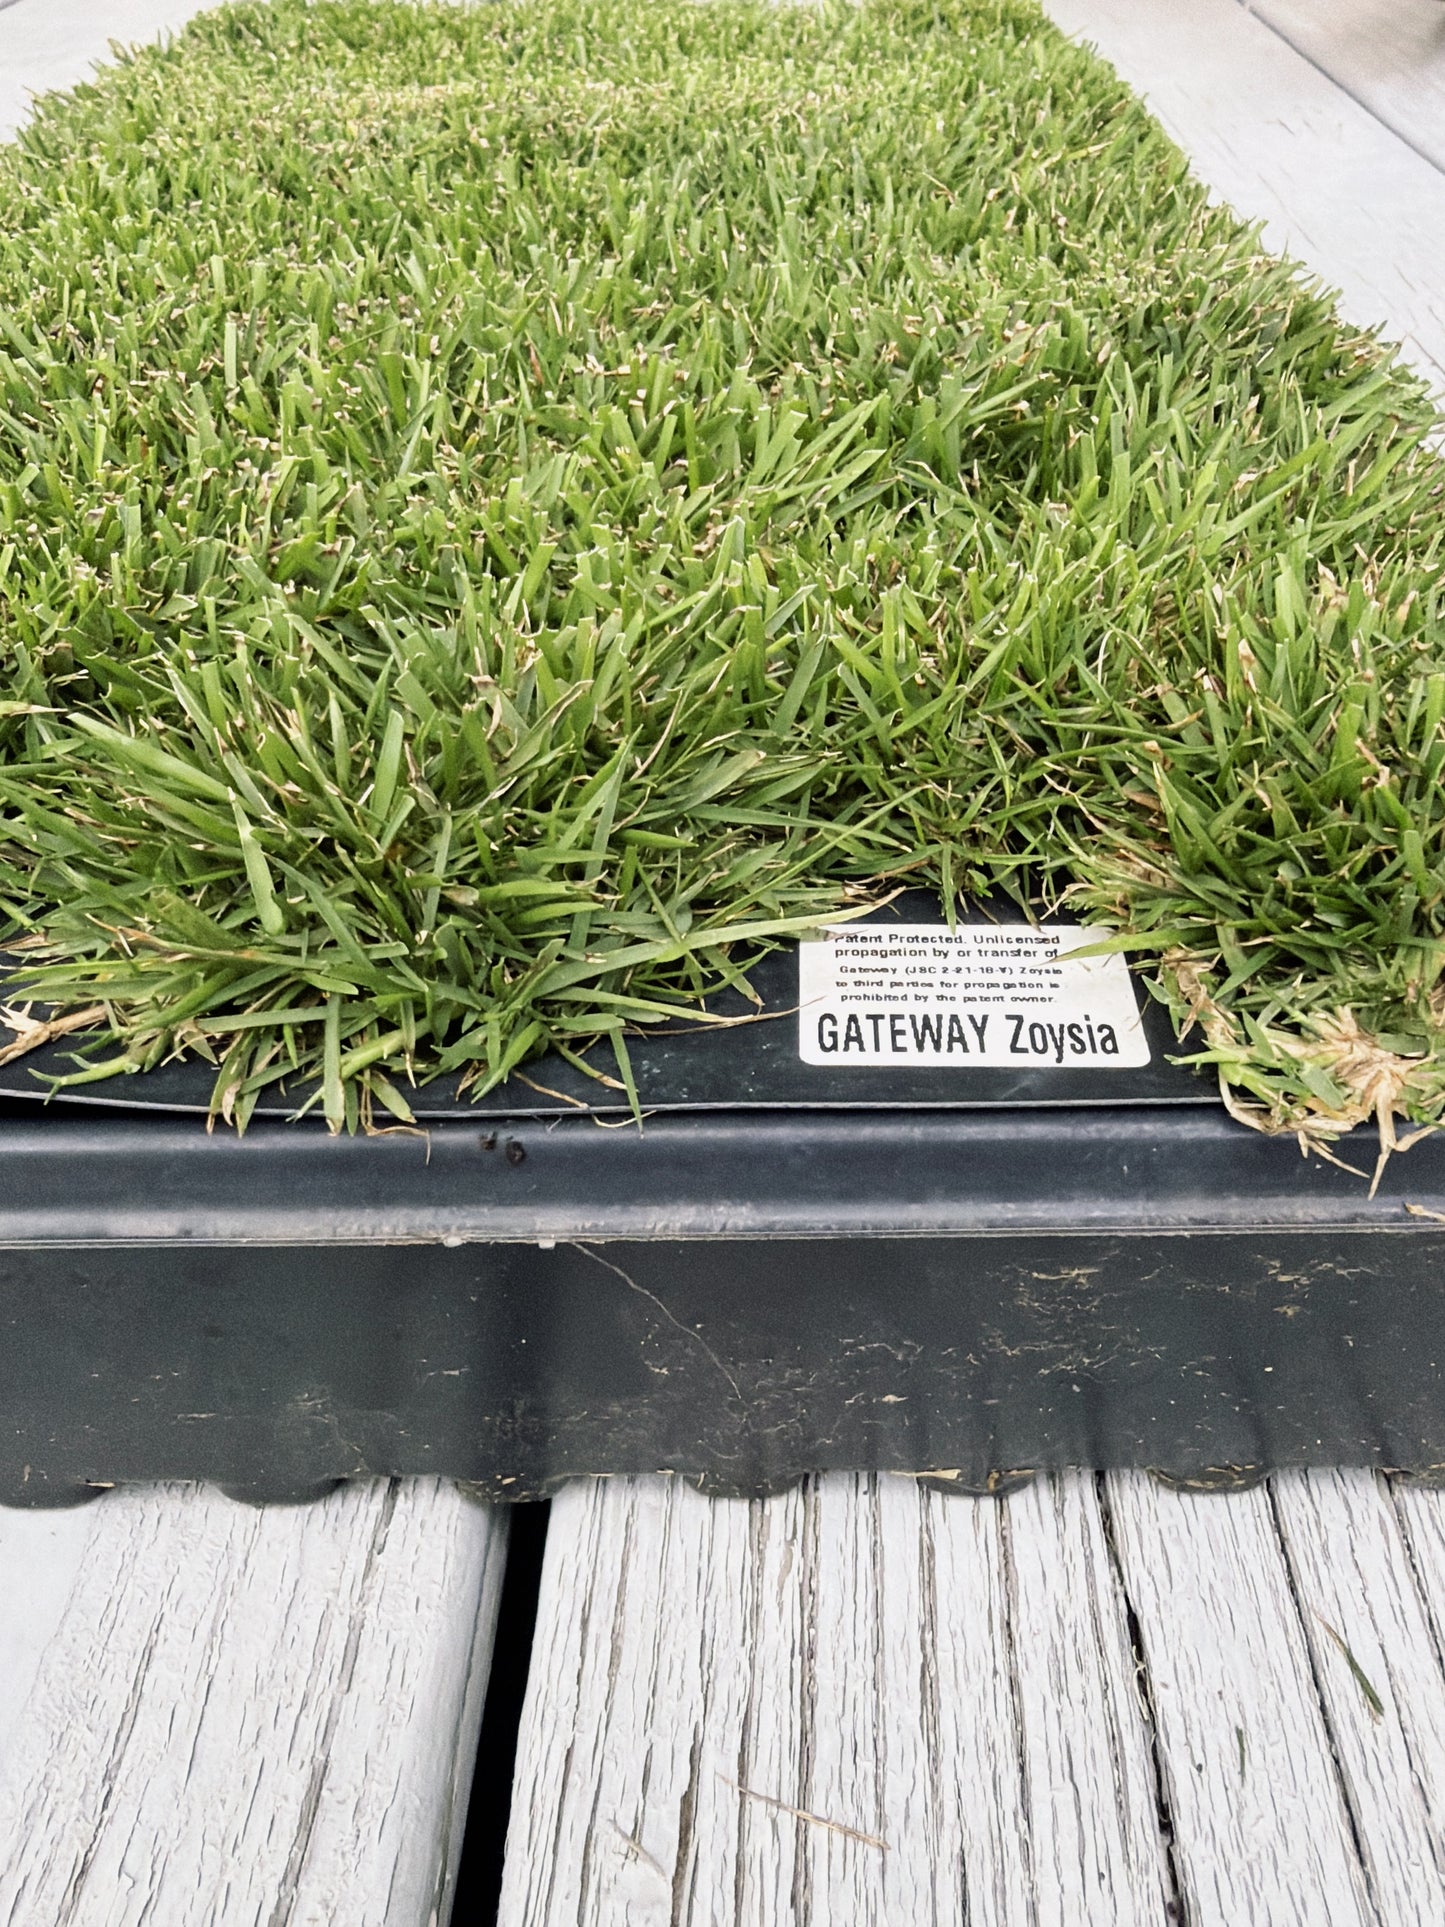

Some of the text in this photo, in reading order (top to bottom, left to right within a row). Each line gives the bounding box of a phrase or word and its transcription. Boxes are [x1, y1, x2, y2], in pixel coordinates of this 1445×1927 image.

[889, 934, 967, 944] Protected.
[974, 935, 1061, 945] Unlicensed
[835, 948, 1059, 960] propagation by or transfer of
[840, 966, 898, 976] Gateway
[1019, 967, 1063, 976] Zoysia
[854, 980, 884, 988] third
[889, 981, 934, 989] parties
[964, 982, 1045, 991] propagation
[840, 994, 909, 1003] prohibited
[914, 994, 930, 1003] by
[963, 995, 1005, 1004] patent
[818, 1013, 1120, 1064] GATEWAY Zoysia
